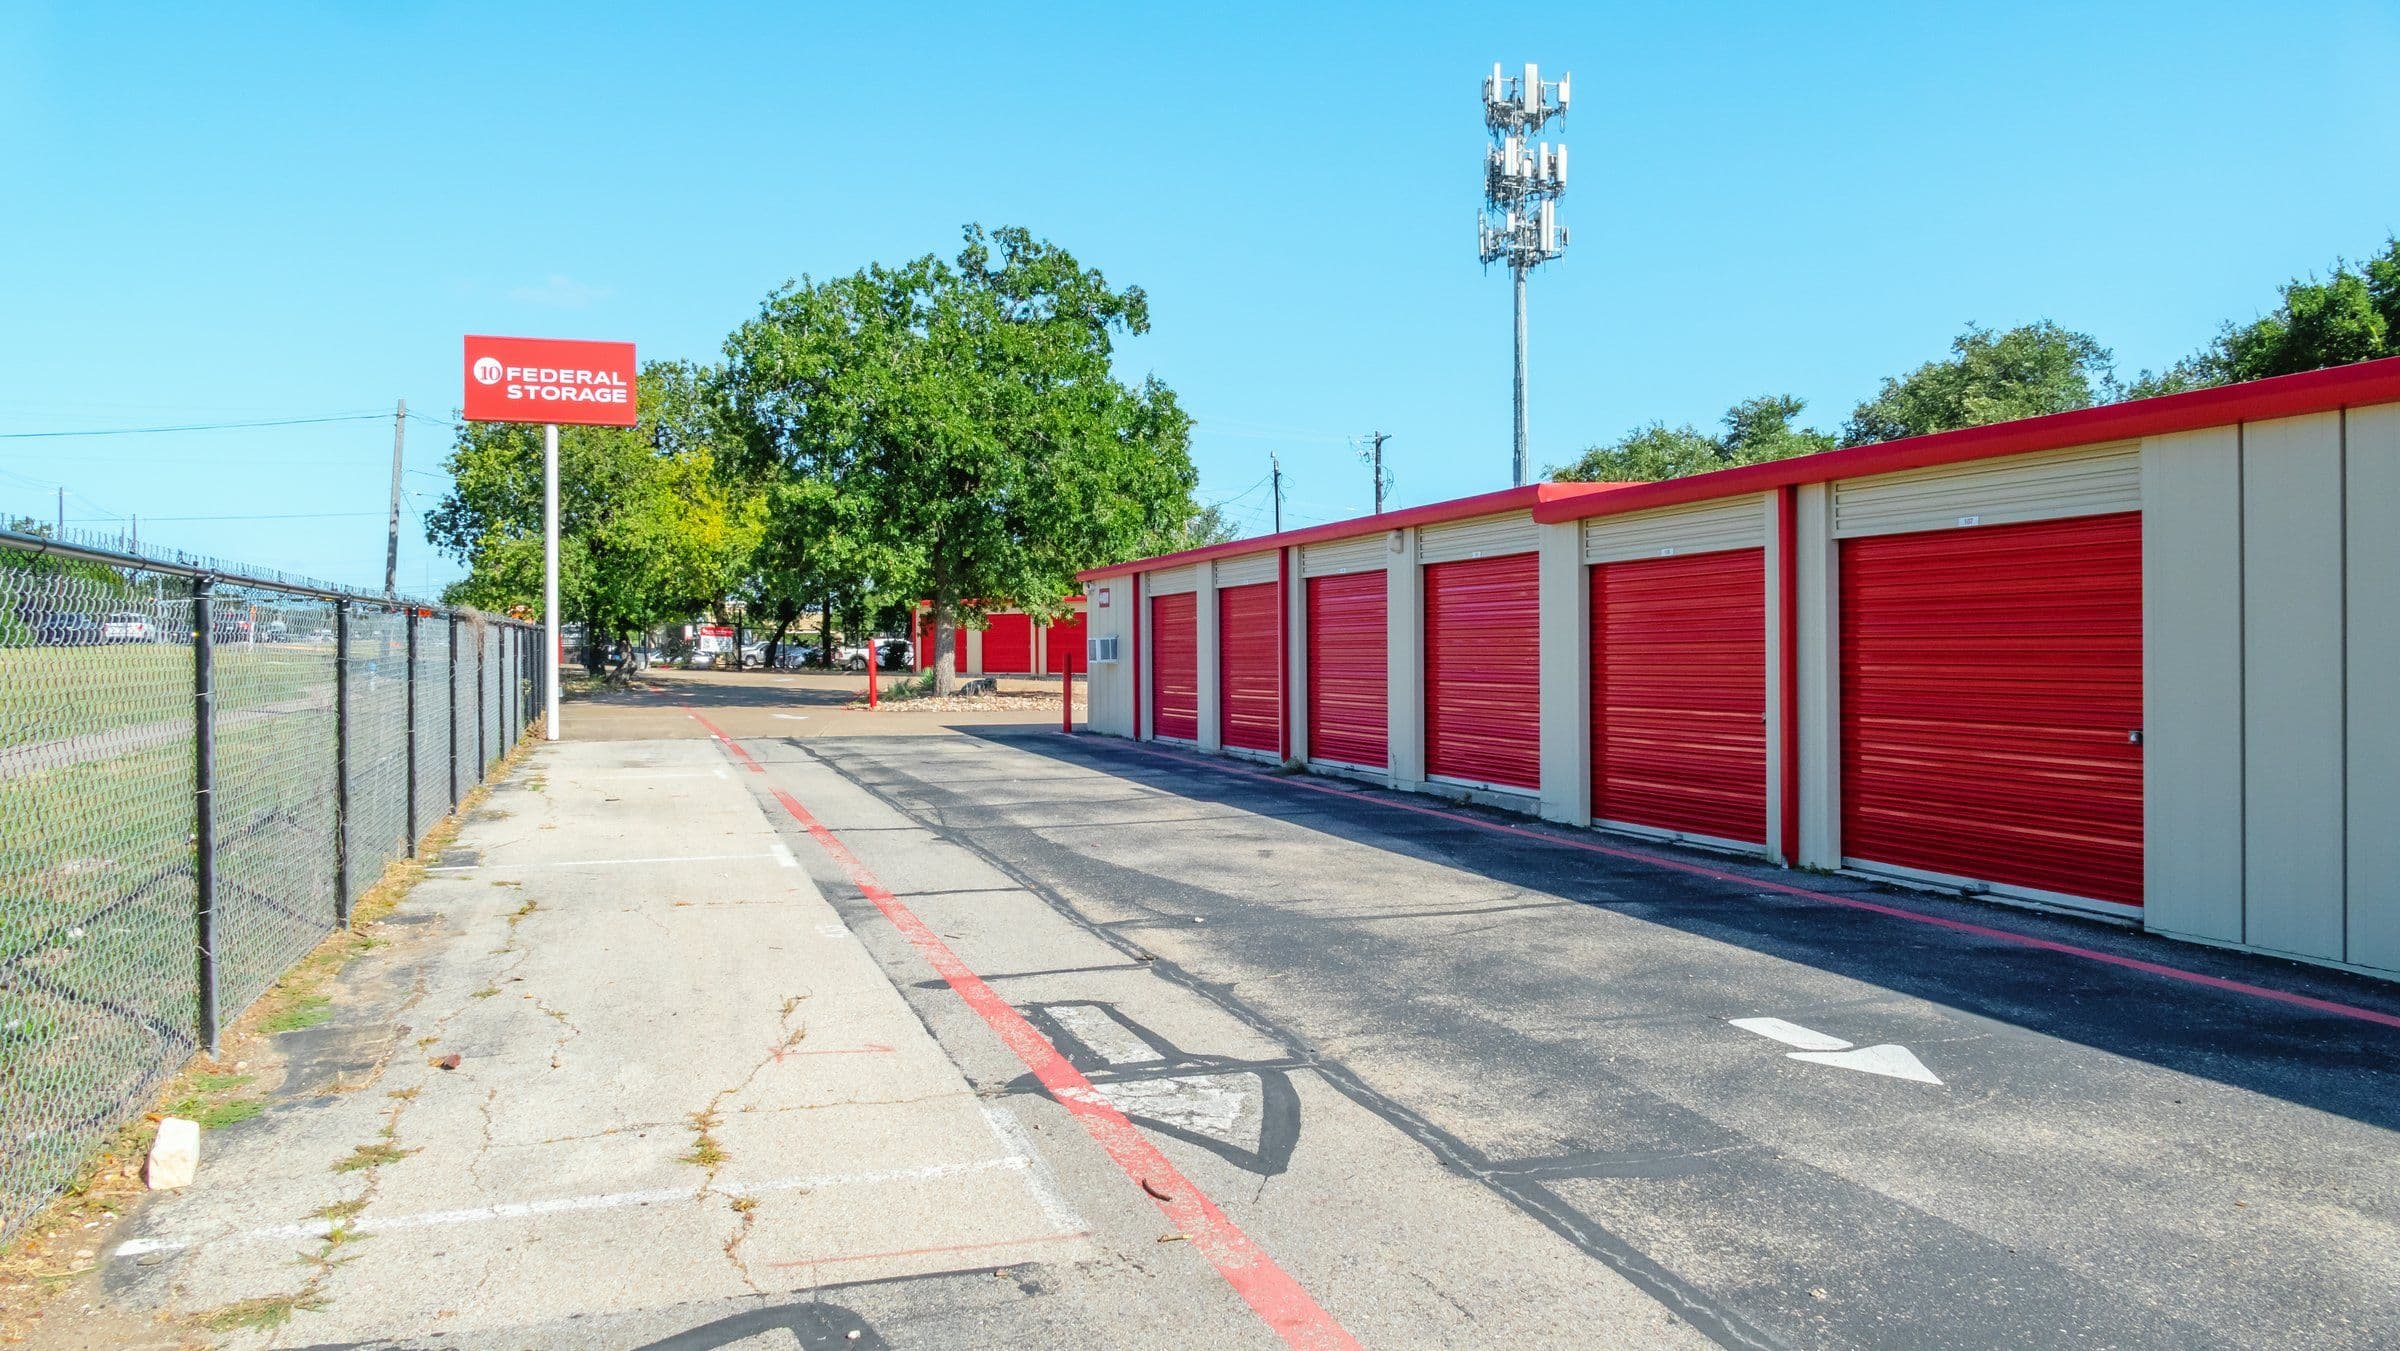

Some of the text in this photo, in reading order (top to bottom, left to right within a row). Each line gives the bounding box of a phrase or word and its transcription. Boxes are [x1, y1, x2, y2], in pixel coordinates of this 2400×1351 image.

[480, 365, 627, 386] 10 FEDERAL
[507, 384, 627, 403] STORAGE
